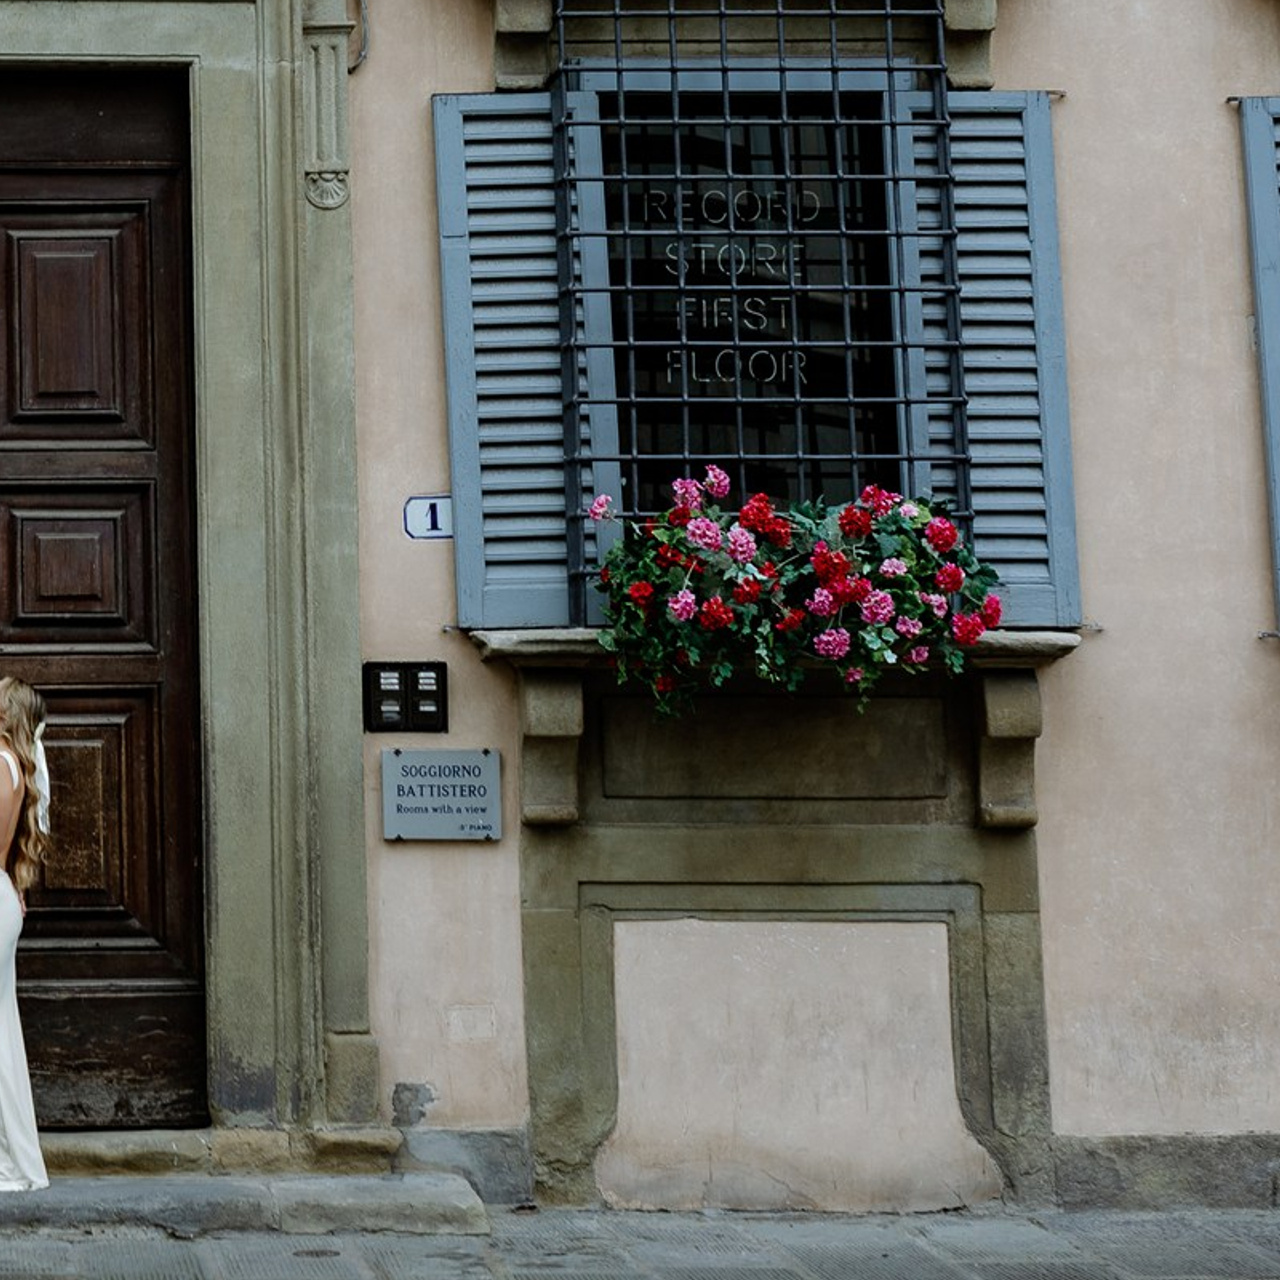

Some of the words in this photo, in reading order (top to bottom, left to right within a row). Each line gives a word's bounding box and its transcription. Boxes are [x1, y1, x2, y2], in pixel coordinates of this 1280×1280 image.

[644, 190, 821, 223] RECORD
[665, 242, 805, 276] STORE
[676, 297, 792, 330] FIRST
[666, 348, 808, 385] FLOOR
[425, 502, 443, 532] 1
[401, 764, 482, 779] SOGGIORNO
[396, 783, 488, 798] BATTISTERO
[396, 803, 429, 814] Rooms
[431, 803, 454, 814] with
[456, 806, 462, 814] a
[464, 803, 488, 814] view
